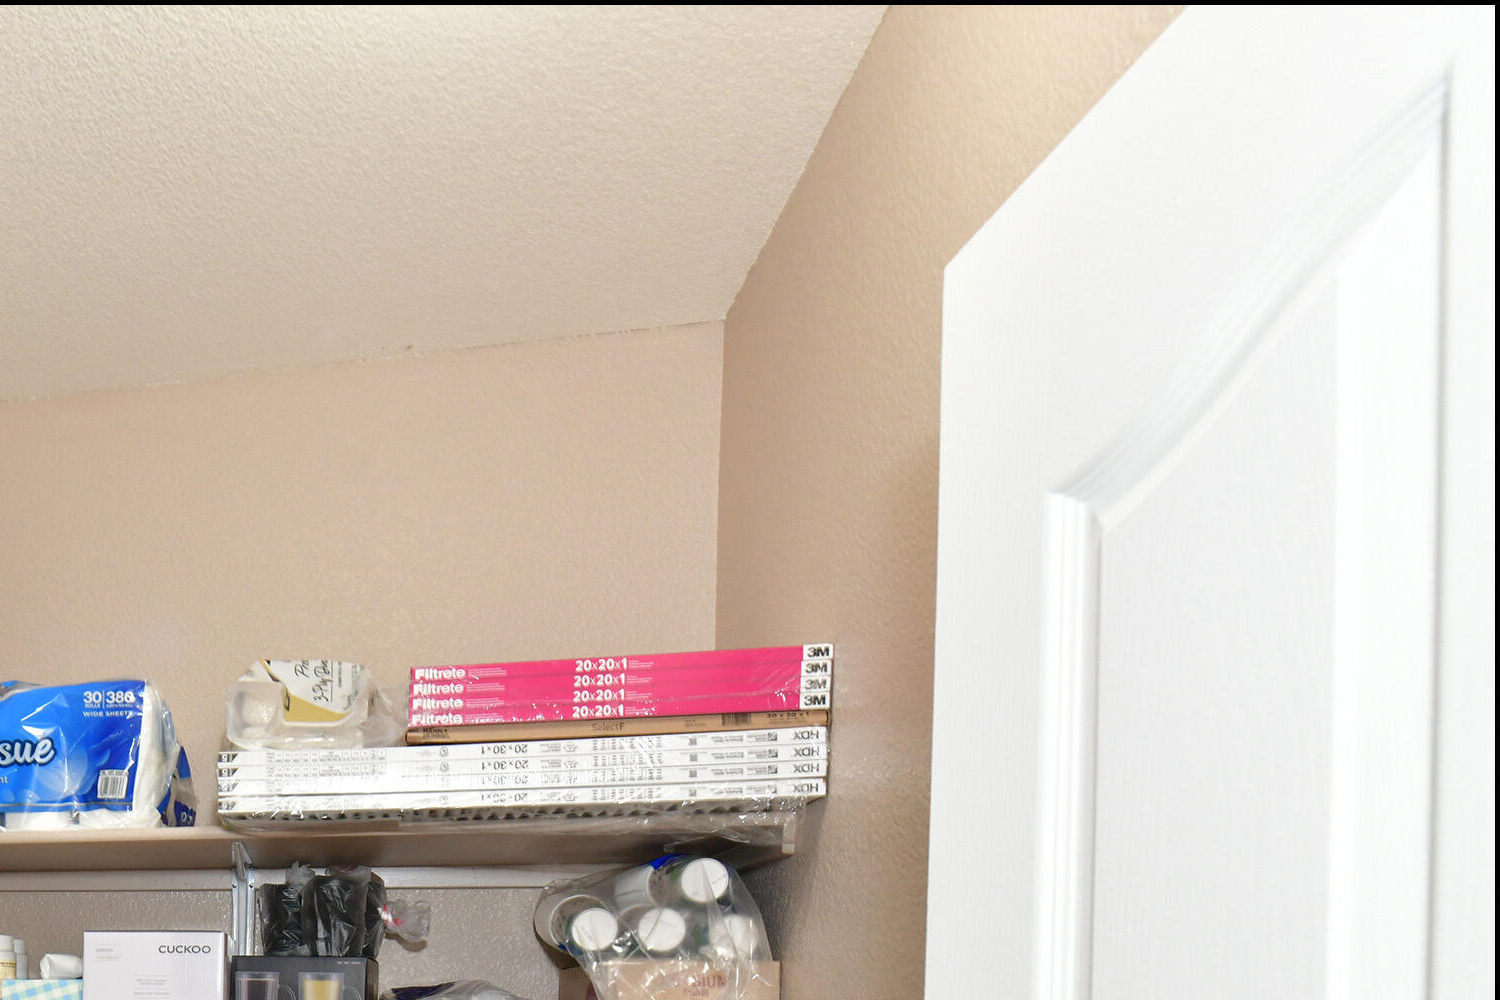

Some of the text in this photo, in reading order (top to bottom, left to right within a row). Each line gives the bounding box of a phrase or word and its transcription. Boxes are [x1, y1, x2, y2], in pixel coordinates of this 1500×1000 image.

[807, 647, 829, 658] 3M
[415, 667, 465, 680] Filtrete
[805, 662, 828, 673] 3M
[414, 682, 464, 695] Filtrete
[804, 678, 827, 689] 3M
[84, 691, 102, 703] 30
[804, 694, 826, 706] 3M
[413, 697, 464, 710] Filtrete
[412, 713, 463, 725] Filtrete
[793, 729, 820, 741] HDX
[793, 746, 820, 758] HDX
[793, 763, 820, 774] HDX
[793, 782, 819, 794] HDX
[158, 944, 212, 954] CUCKOO
